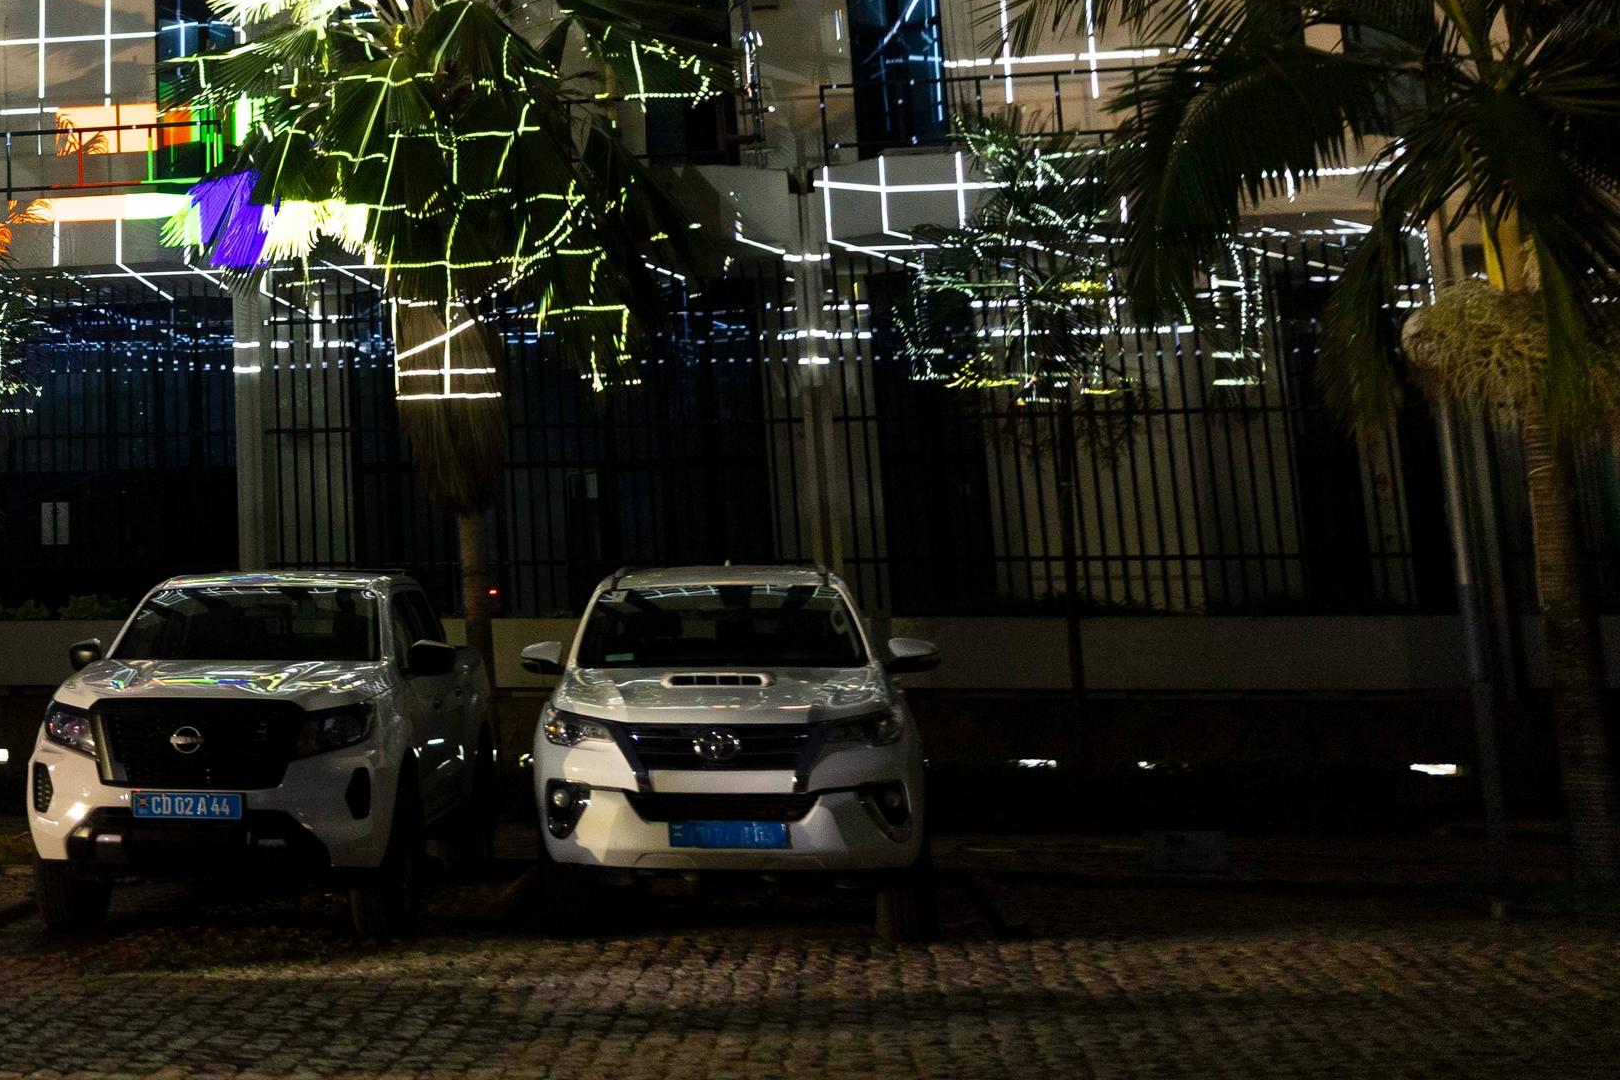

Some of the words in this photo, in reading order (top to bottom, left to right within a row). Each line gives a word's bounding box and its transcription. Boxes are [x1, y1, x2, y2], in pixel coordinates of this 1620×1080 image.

[151, 796, 172, 815] CD
[174, 796, 195, 816] 02
[197, 797, 208, 816] A
[211, 797, 230, 816] 44
